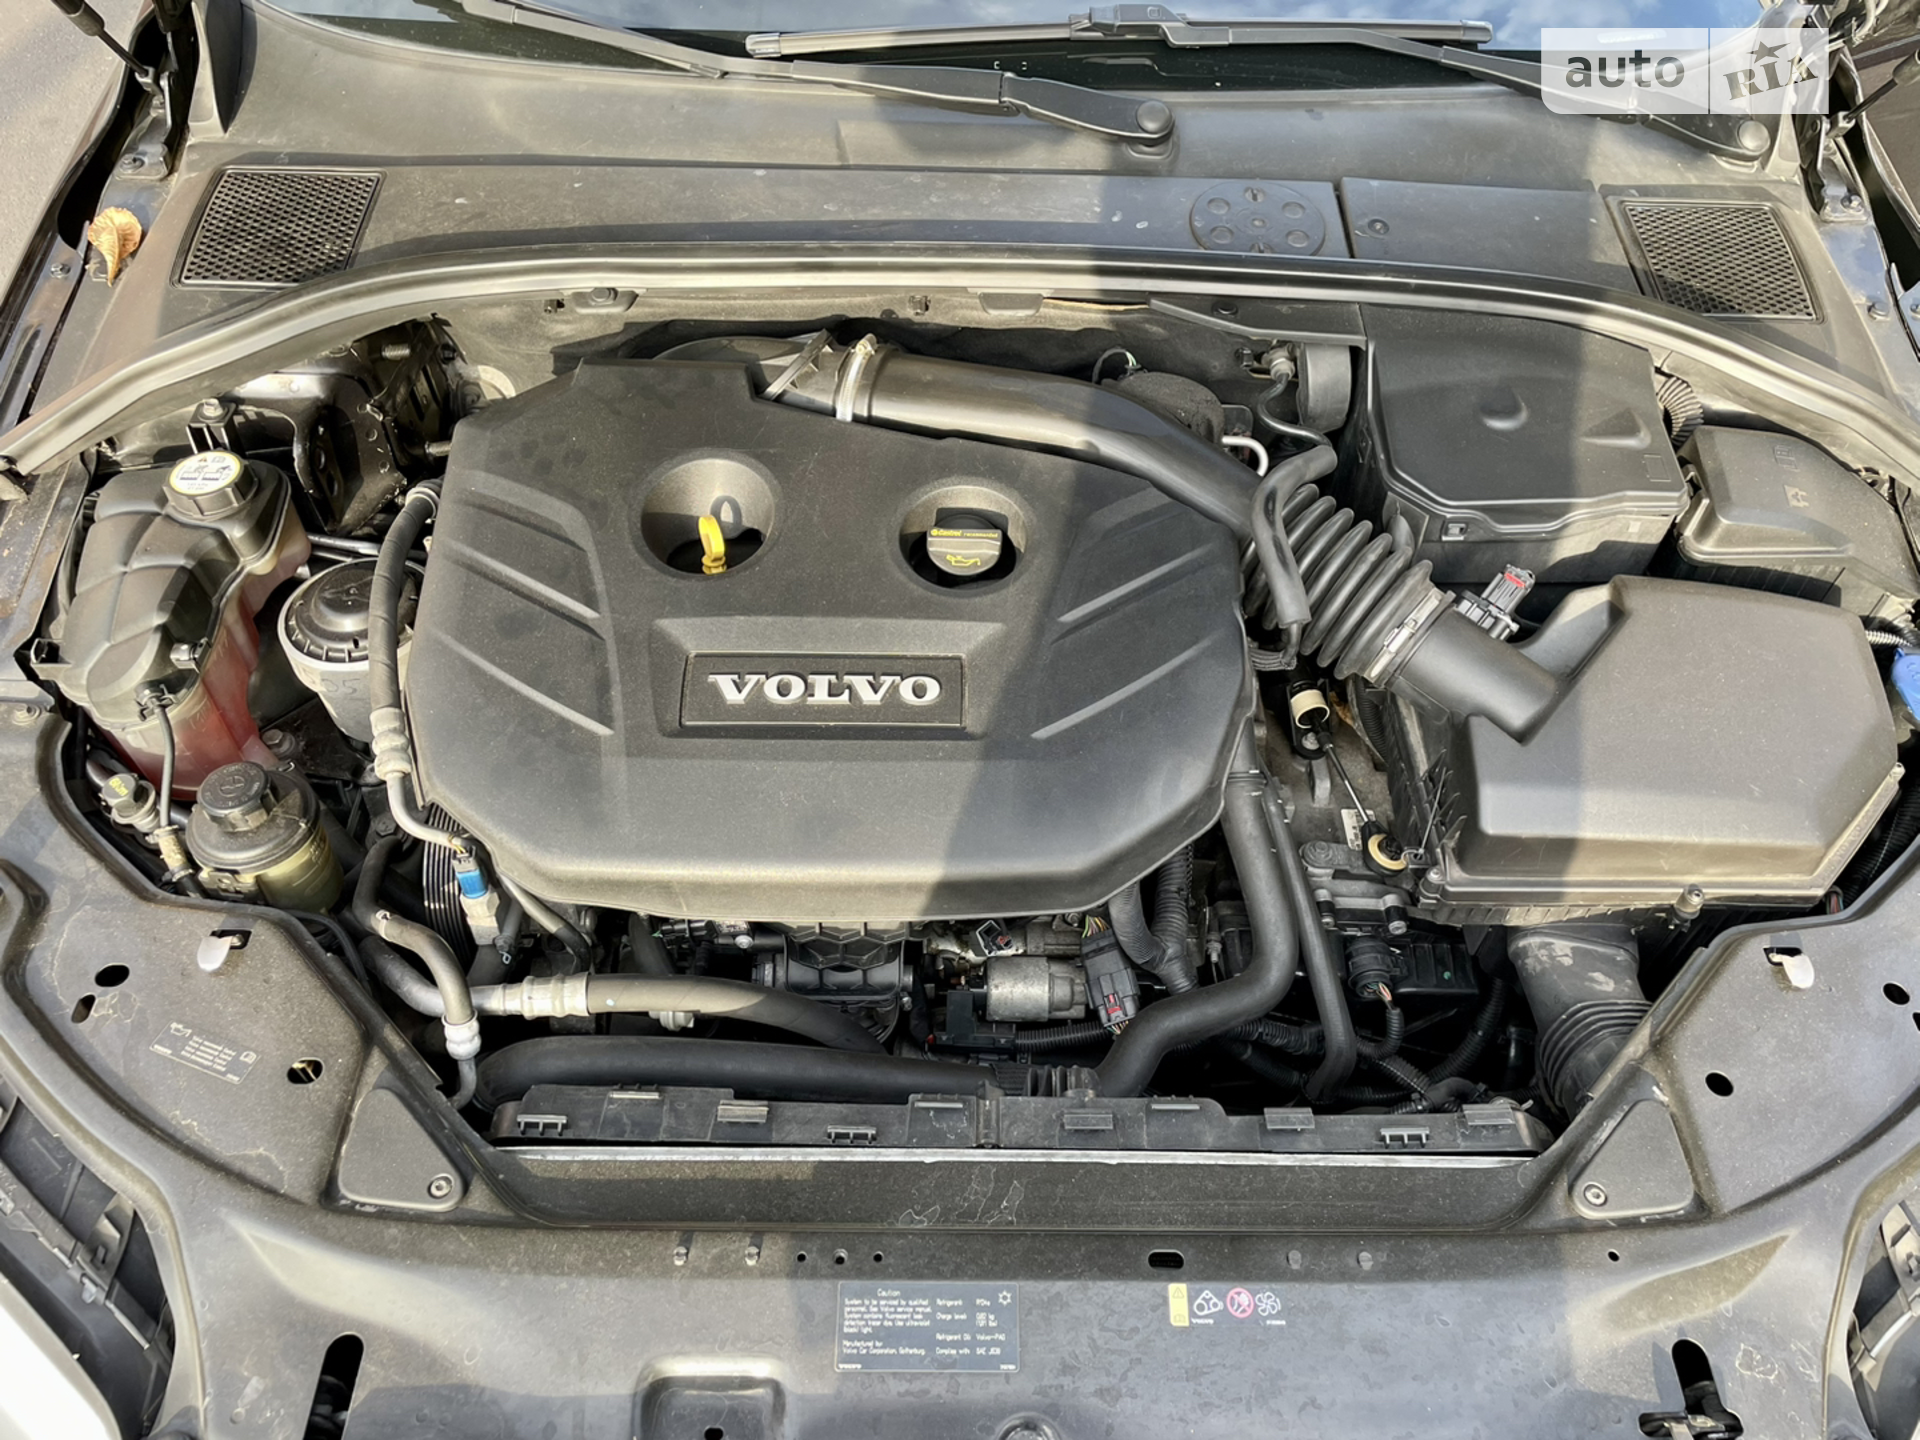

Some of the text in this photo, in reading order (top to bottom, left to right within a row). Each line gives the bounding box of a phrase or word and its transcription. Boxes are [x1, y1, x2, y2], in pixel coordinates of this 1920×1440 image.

[938, 529, 962, 537] Castrol
[707, 670, 941, 705] VOLVO
[877, 1288, 901, 1297] Caution
